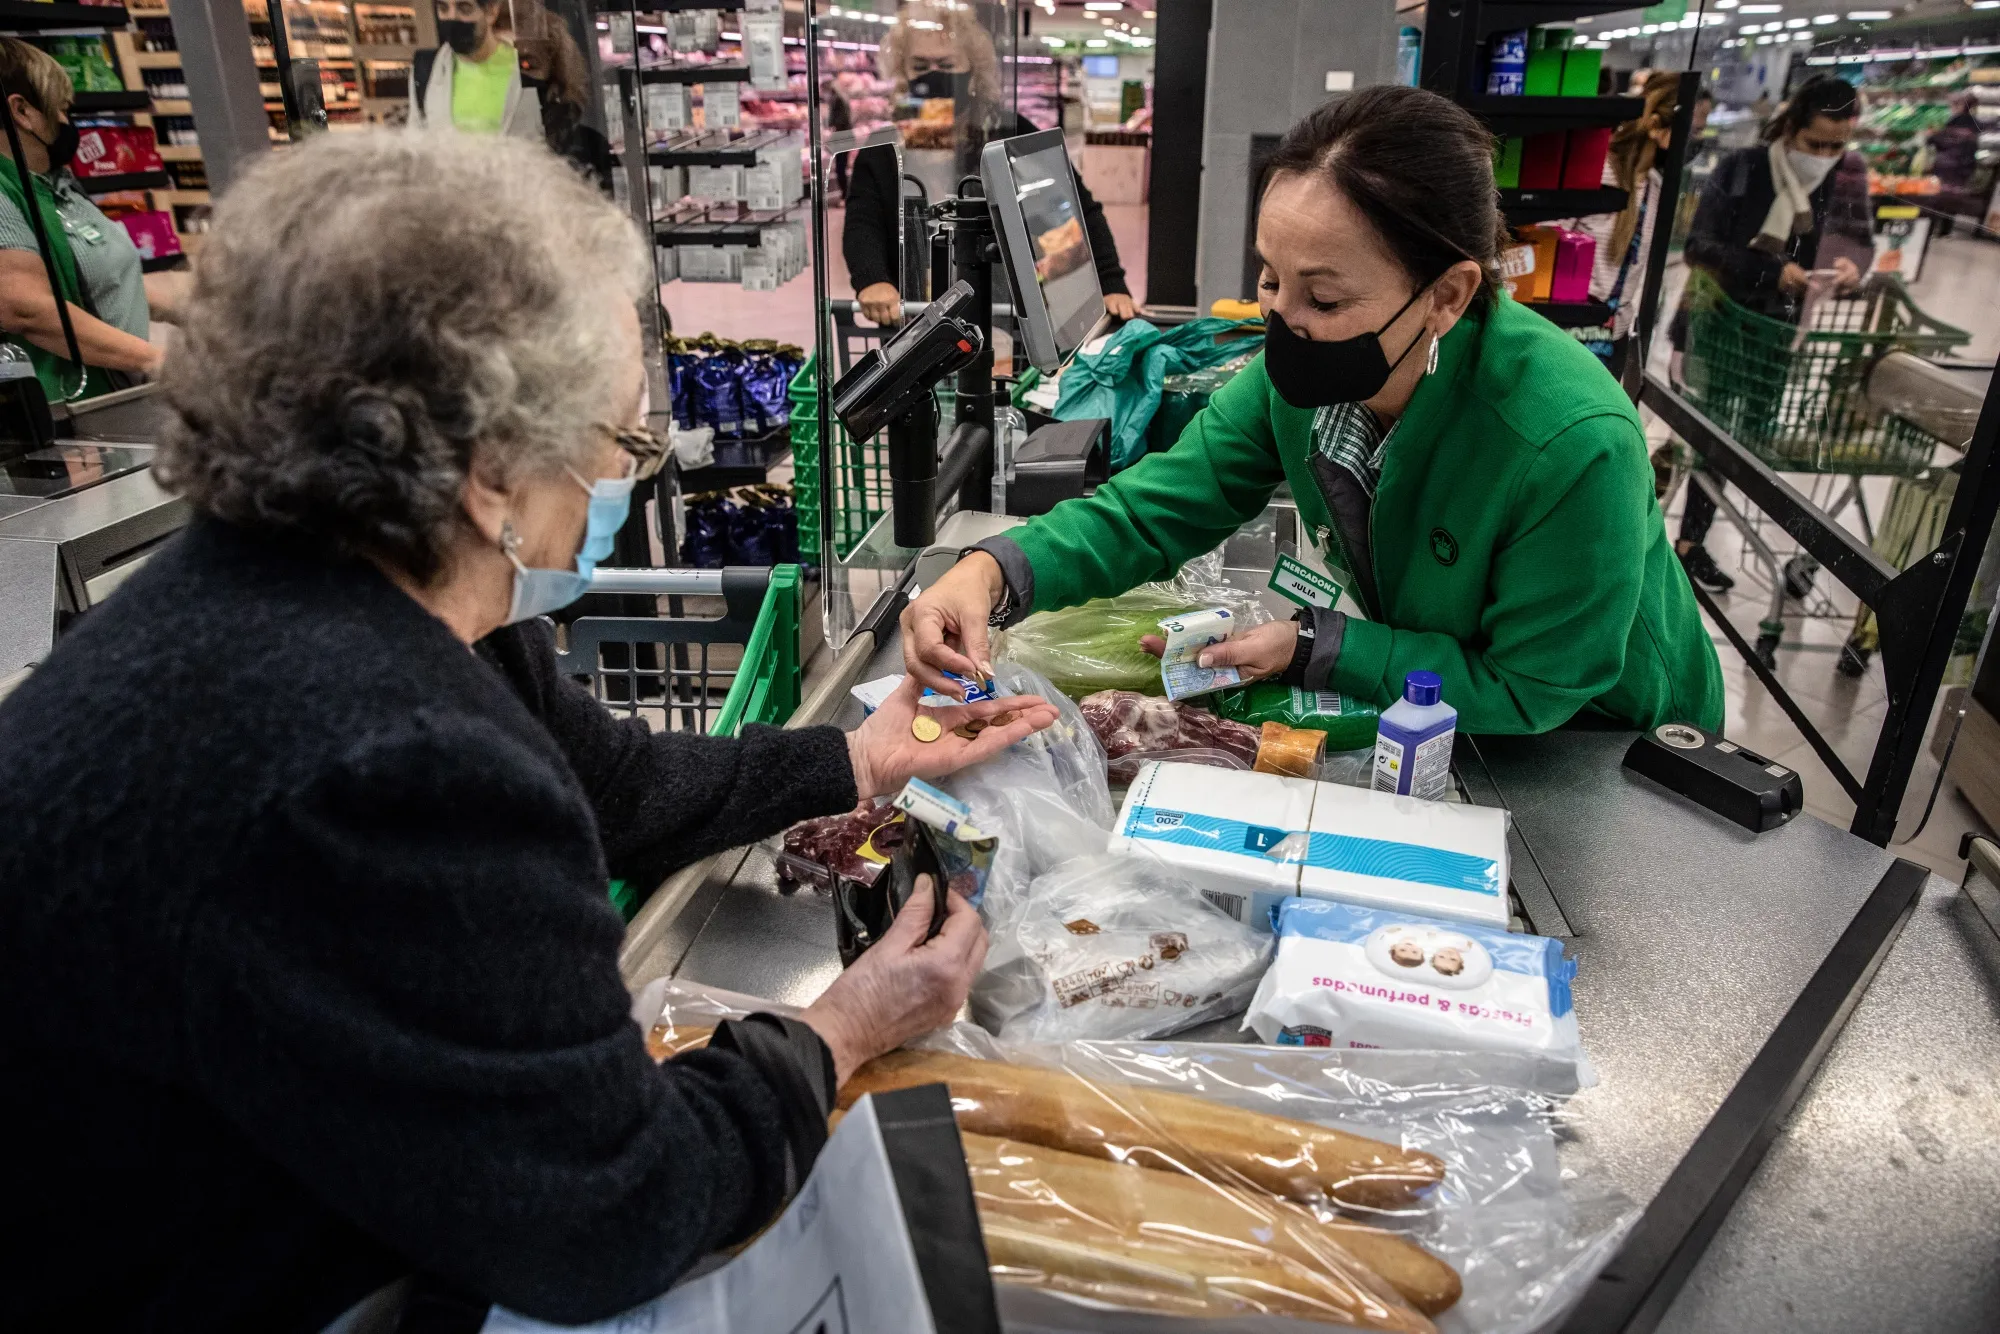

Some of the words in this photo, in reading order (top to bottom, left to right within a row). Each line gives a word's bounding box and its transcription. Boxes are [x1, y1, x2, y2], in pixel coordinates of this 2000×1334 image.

[1282, 559, 1336, 594] MERCADONA
[1291, 582, 1316, 599] JULIA
[1156, 816, 1179, 826] 200
[1312, 976, 1430, 1006] perfumadas
[1437, 999, 1451, 1012] &
